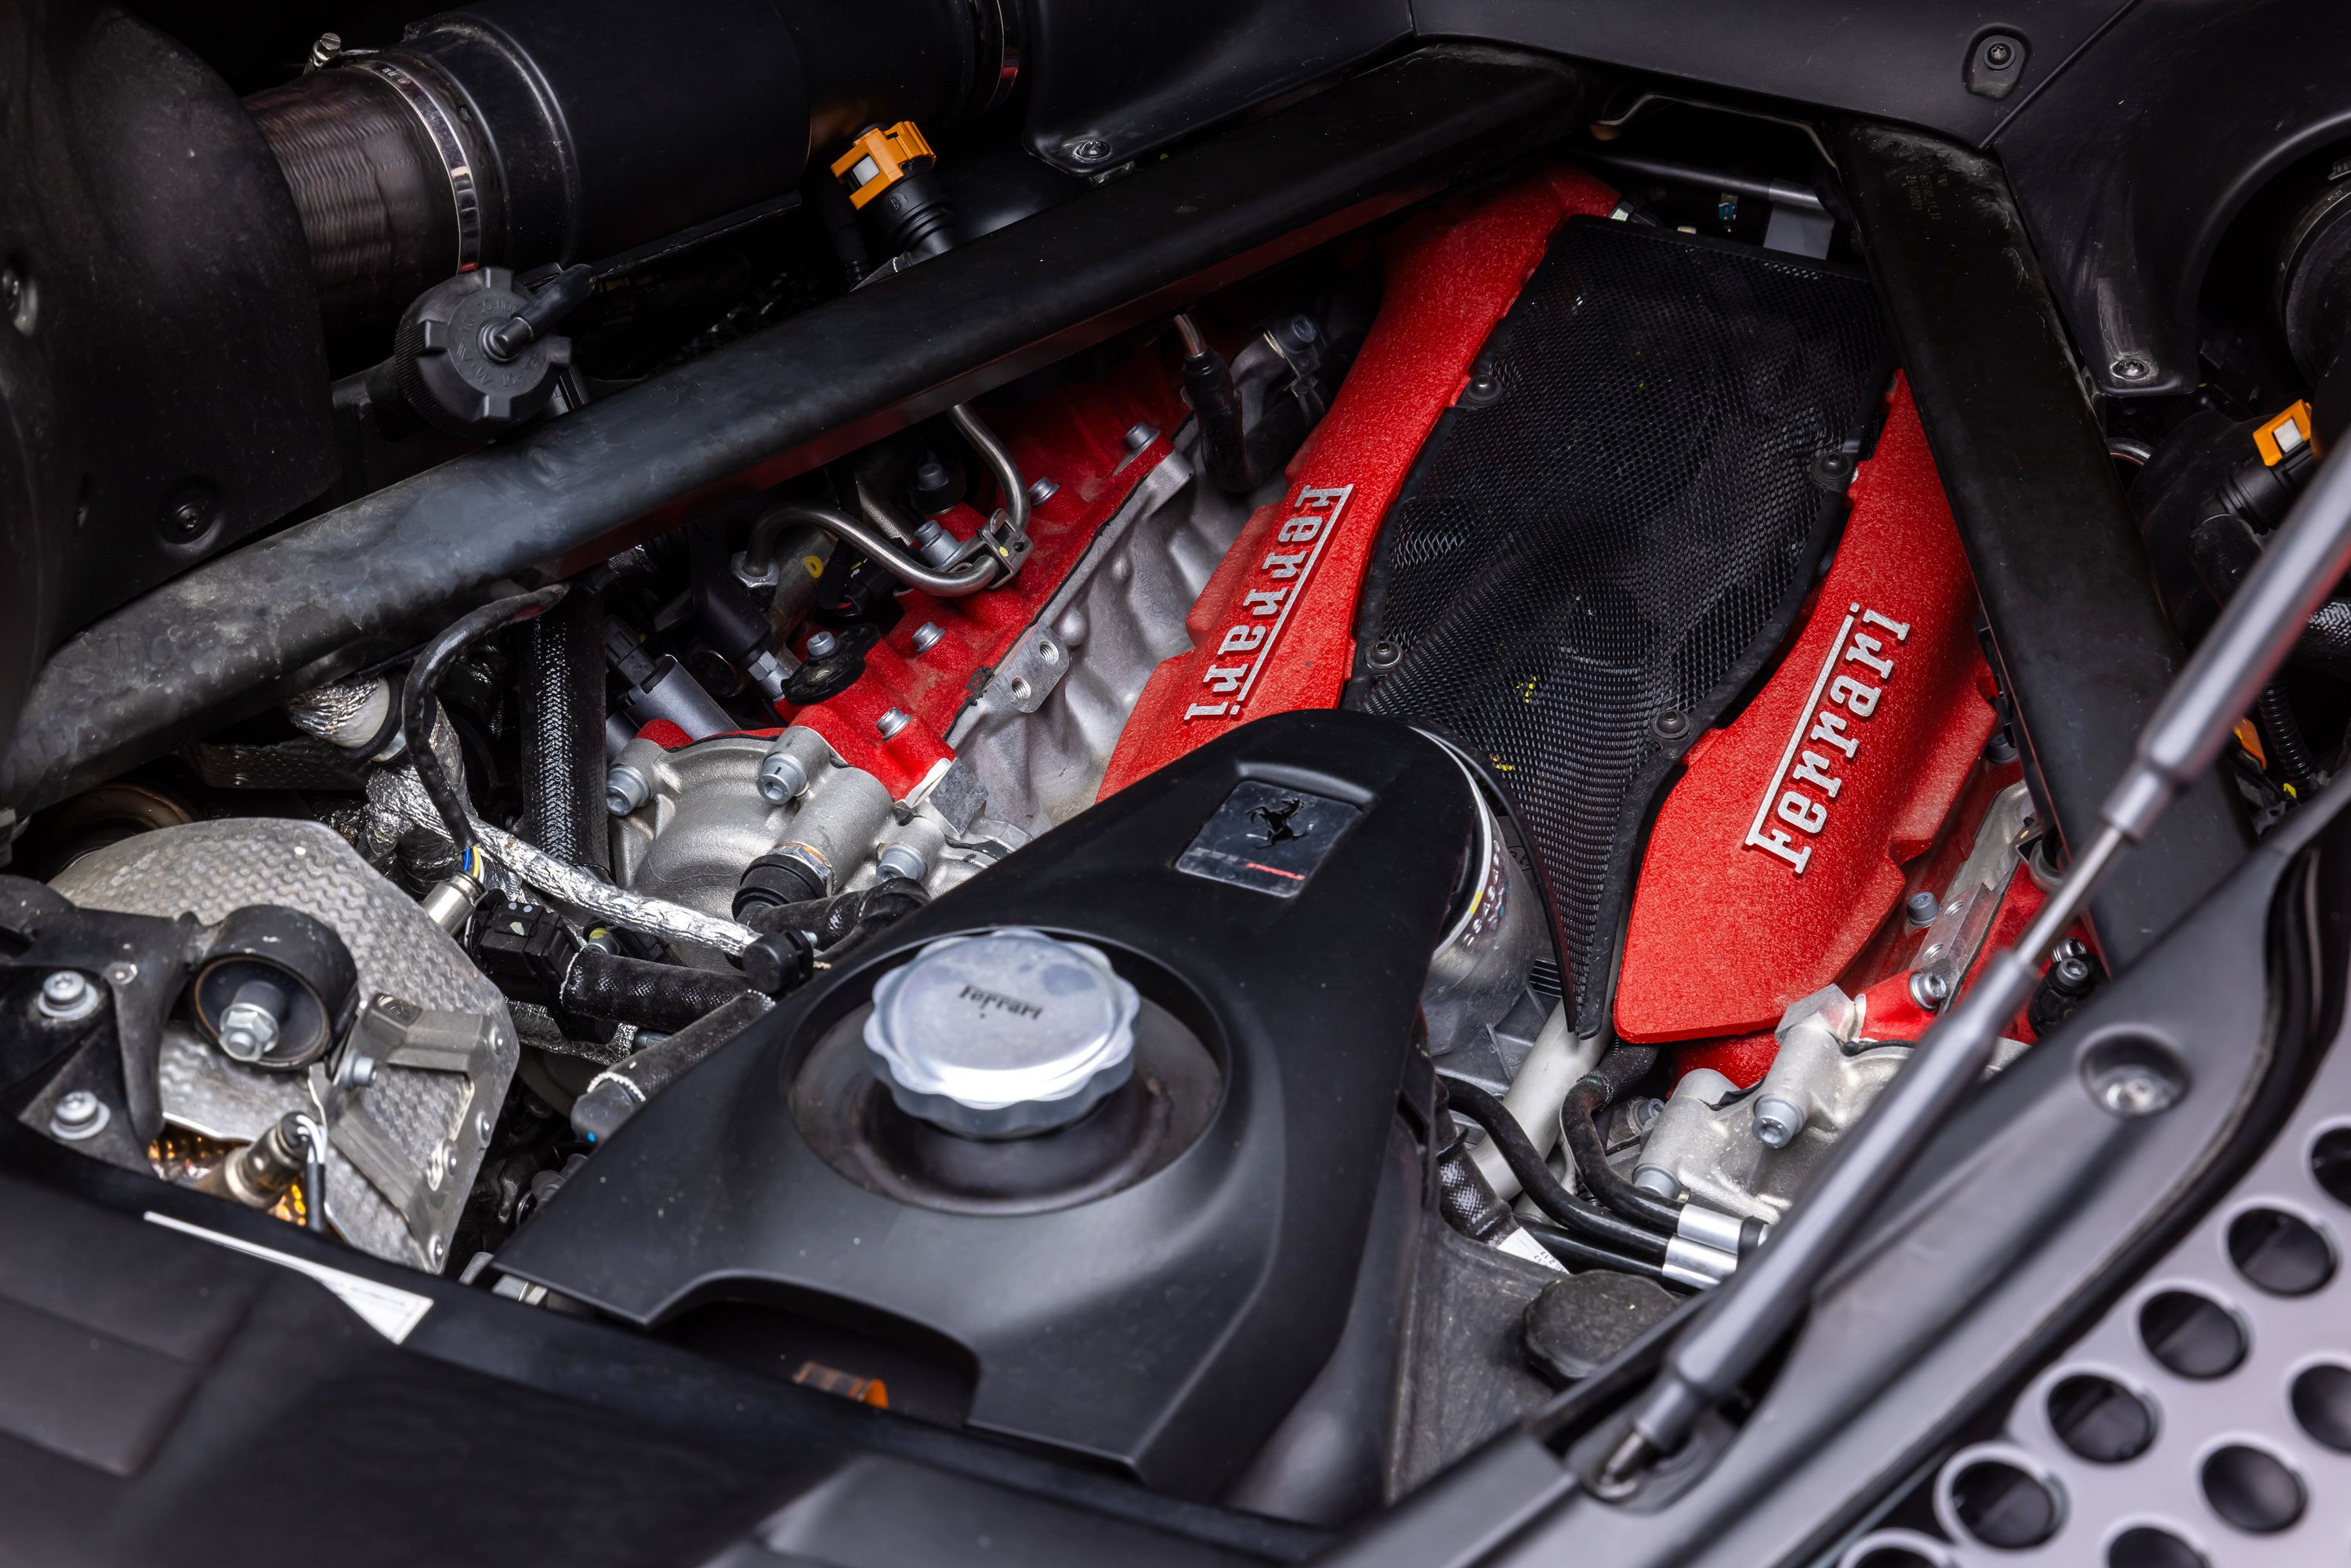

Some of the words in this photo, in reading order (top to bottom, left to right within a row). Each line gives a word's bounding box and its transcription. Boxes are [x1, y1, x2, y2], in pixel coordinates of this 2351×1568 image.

[1183, 483, 1353, 720] Ferrari
[1745, 602, 1910, 874] Ferrari
[959, 985, 1042, 1020] Ferrari
